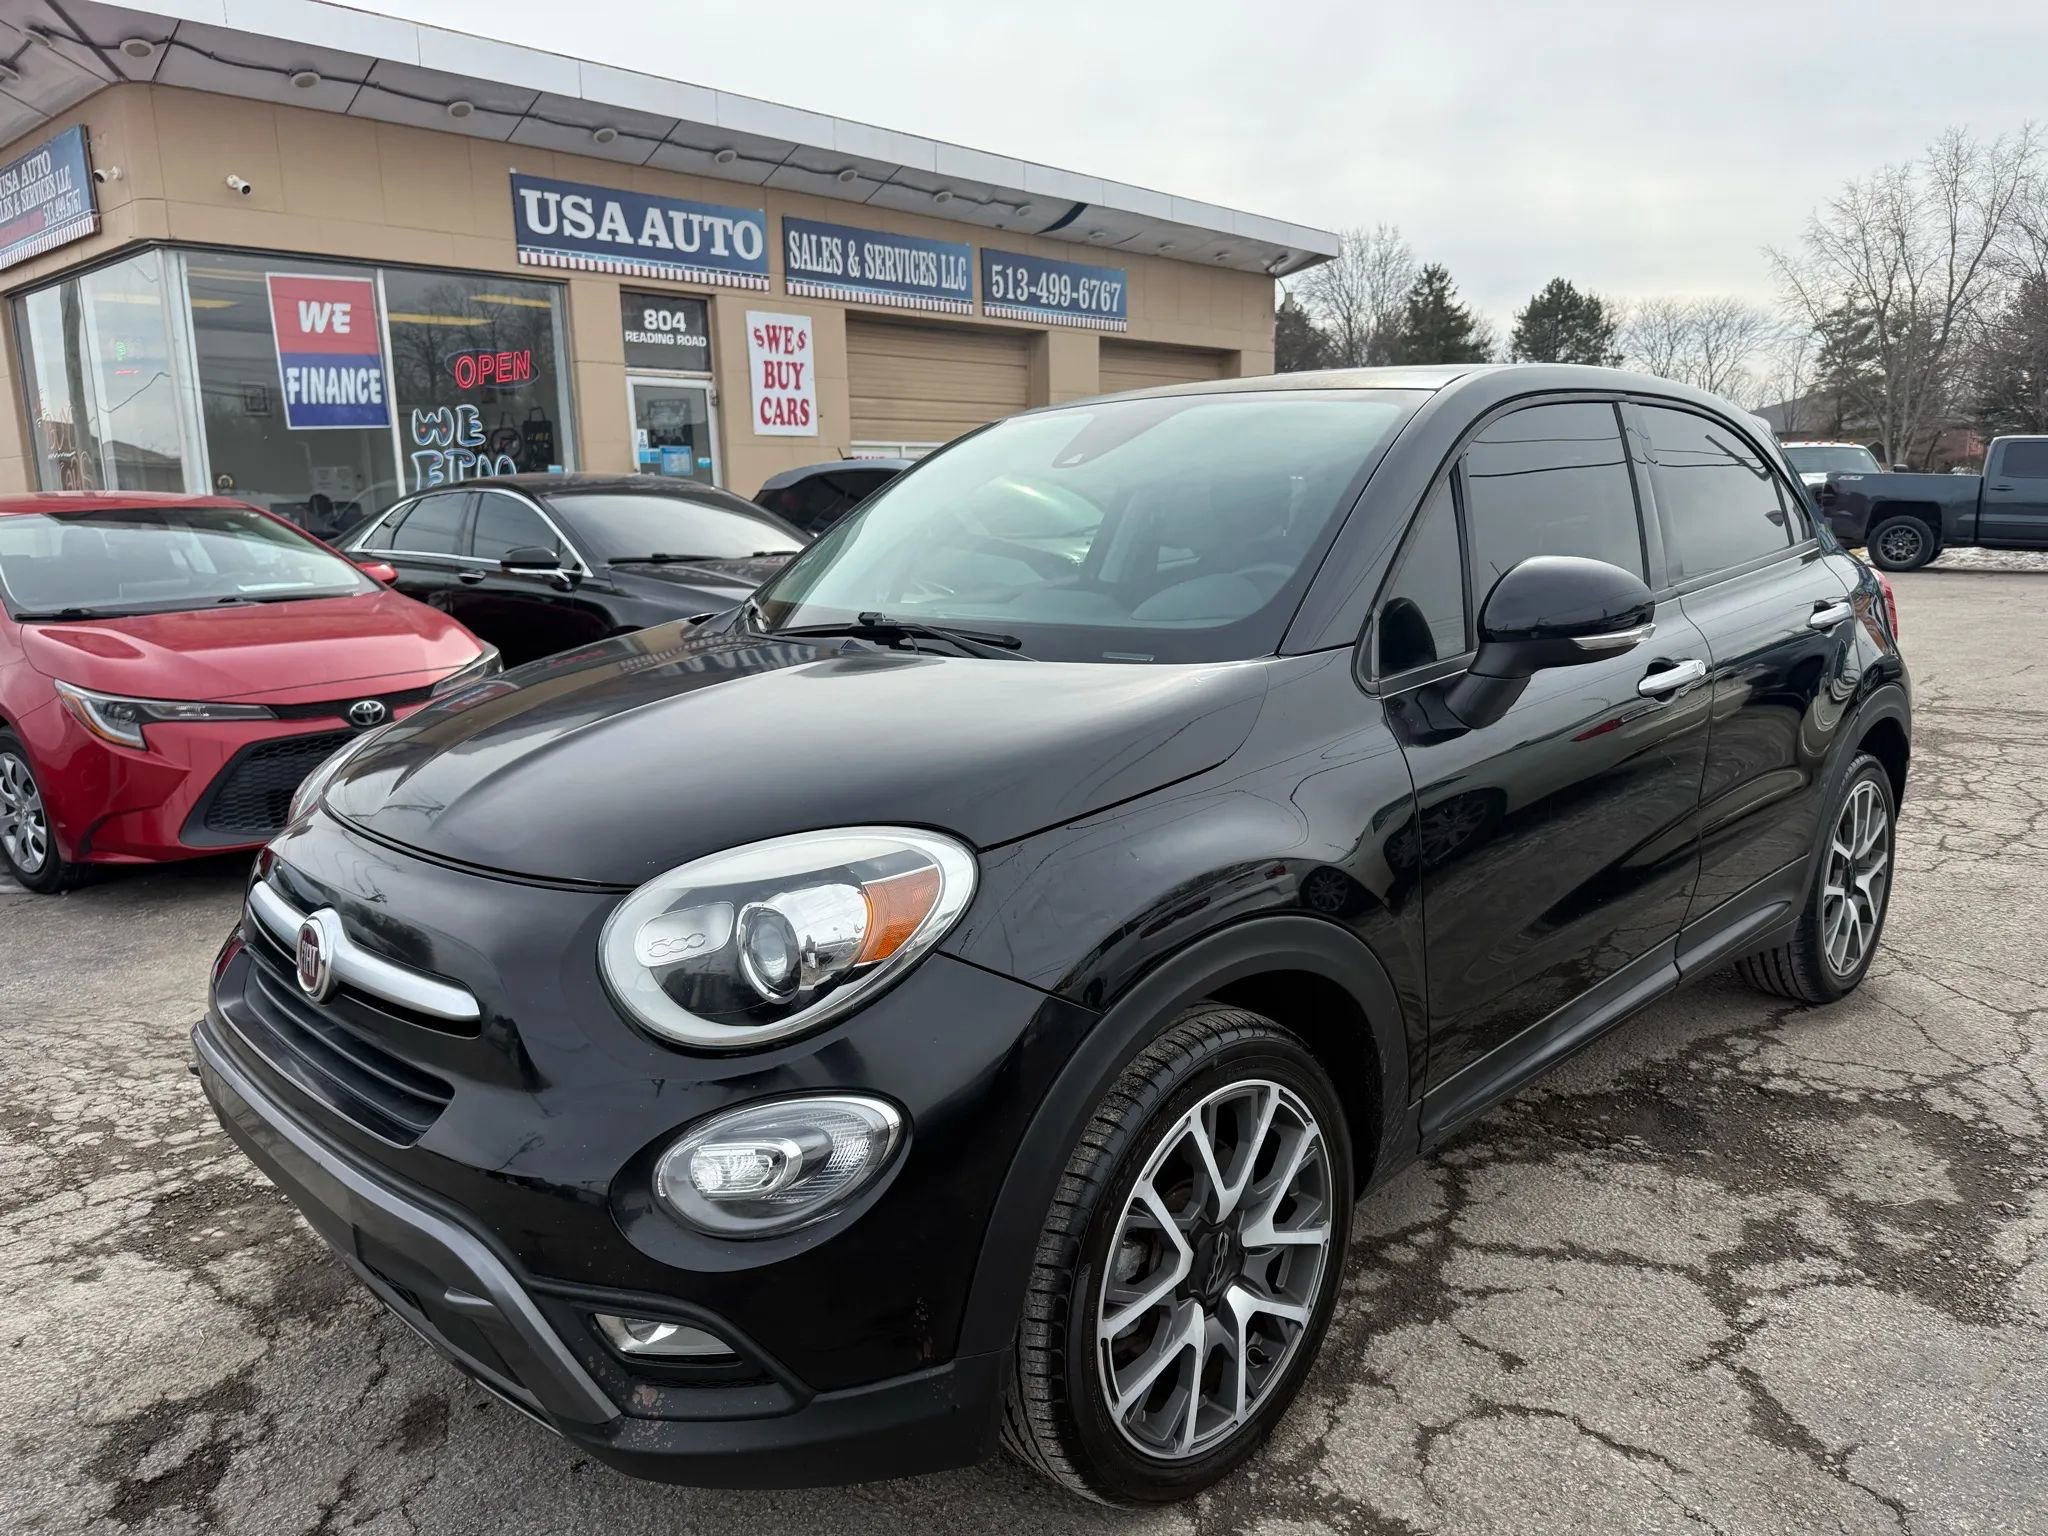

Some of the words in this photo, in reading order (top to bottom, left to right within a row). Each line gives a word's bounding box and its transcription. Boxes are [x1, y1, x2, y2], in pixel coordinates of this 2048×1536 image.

[21, 150, 51, 188] AUTO
[20, 174, 56, 213] SERVICES
[55, 165, 72, 194] LLC
[519, 188, 634, 244] USA
[638, 207, 764, 261] AUTO
[788, 230, 843, 275] SALES
[848, 240, 861, 277] &
[864, 242, 938, 288] SERVICES
[941, 250, 967, 291] LLC
[991, 264, 1122, 312] 513-499-6767
[298, 300, 352, 334] WE
[643, 309, 687, 332] 804
[625, 331, 675, 345] READING
[677, 334, 707, 347] ROAD
[286, 366, 382, 405] FINANCE
[455, 350, 531, 390] OPEN
[763, 360, 804, 390] BUY
[412, 404, 487, 447] WE
[760, 397, 810, 426] CARS
